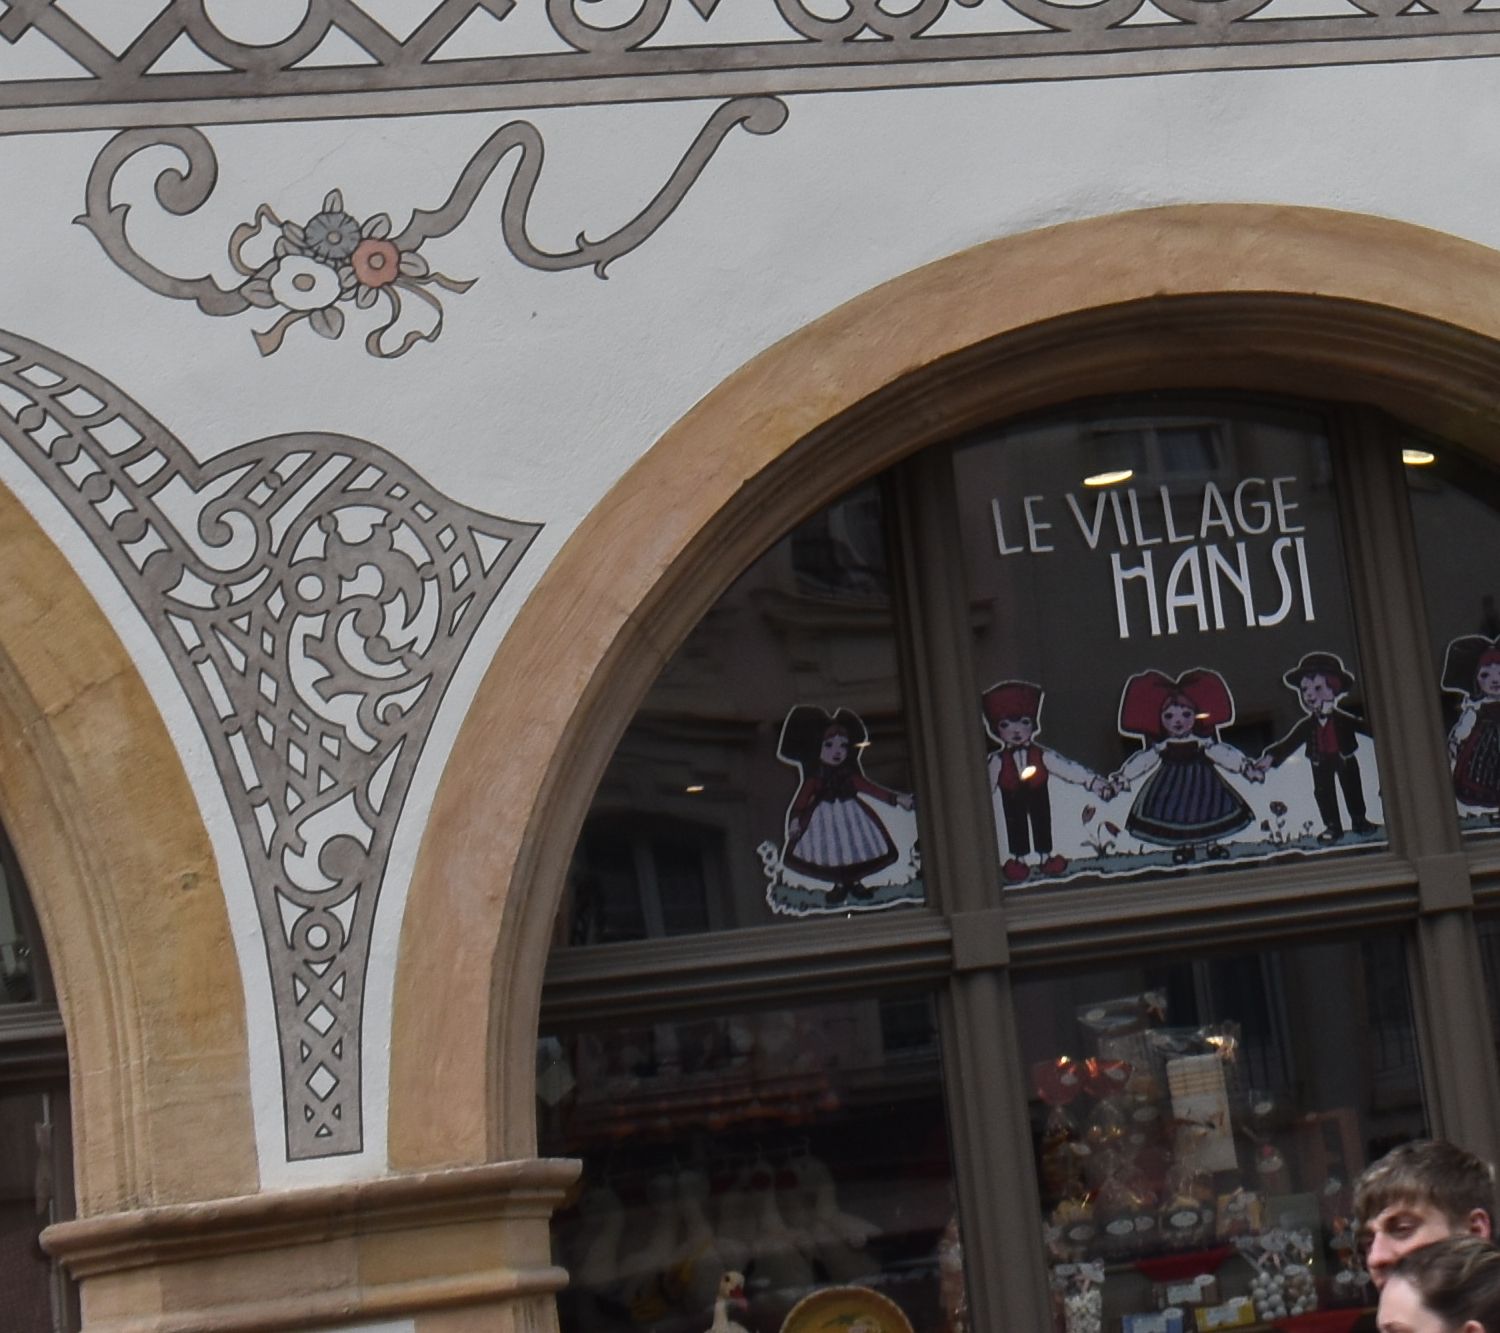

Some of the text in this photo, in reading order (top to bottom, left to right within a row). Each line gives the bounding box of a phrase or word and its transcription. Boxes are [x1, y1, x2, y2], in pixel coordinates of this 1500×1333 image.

[991, 476, 1306, 555] LE VILLAGE
[1110, 536, 1316, 639] HANSI
